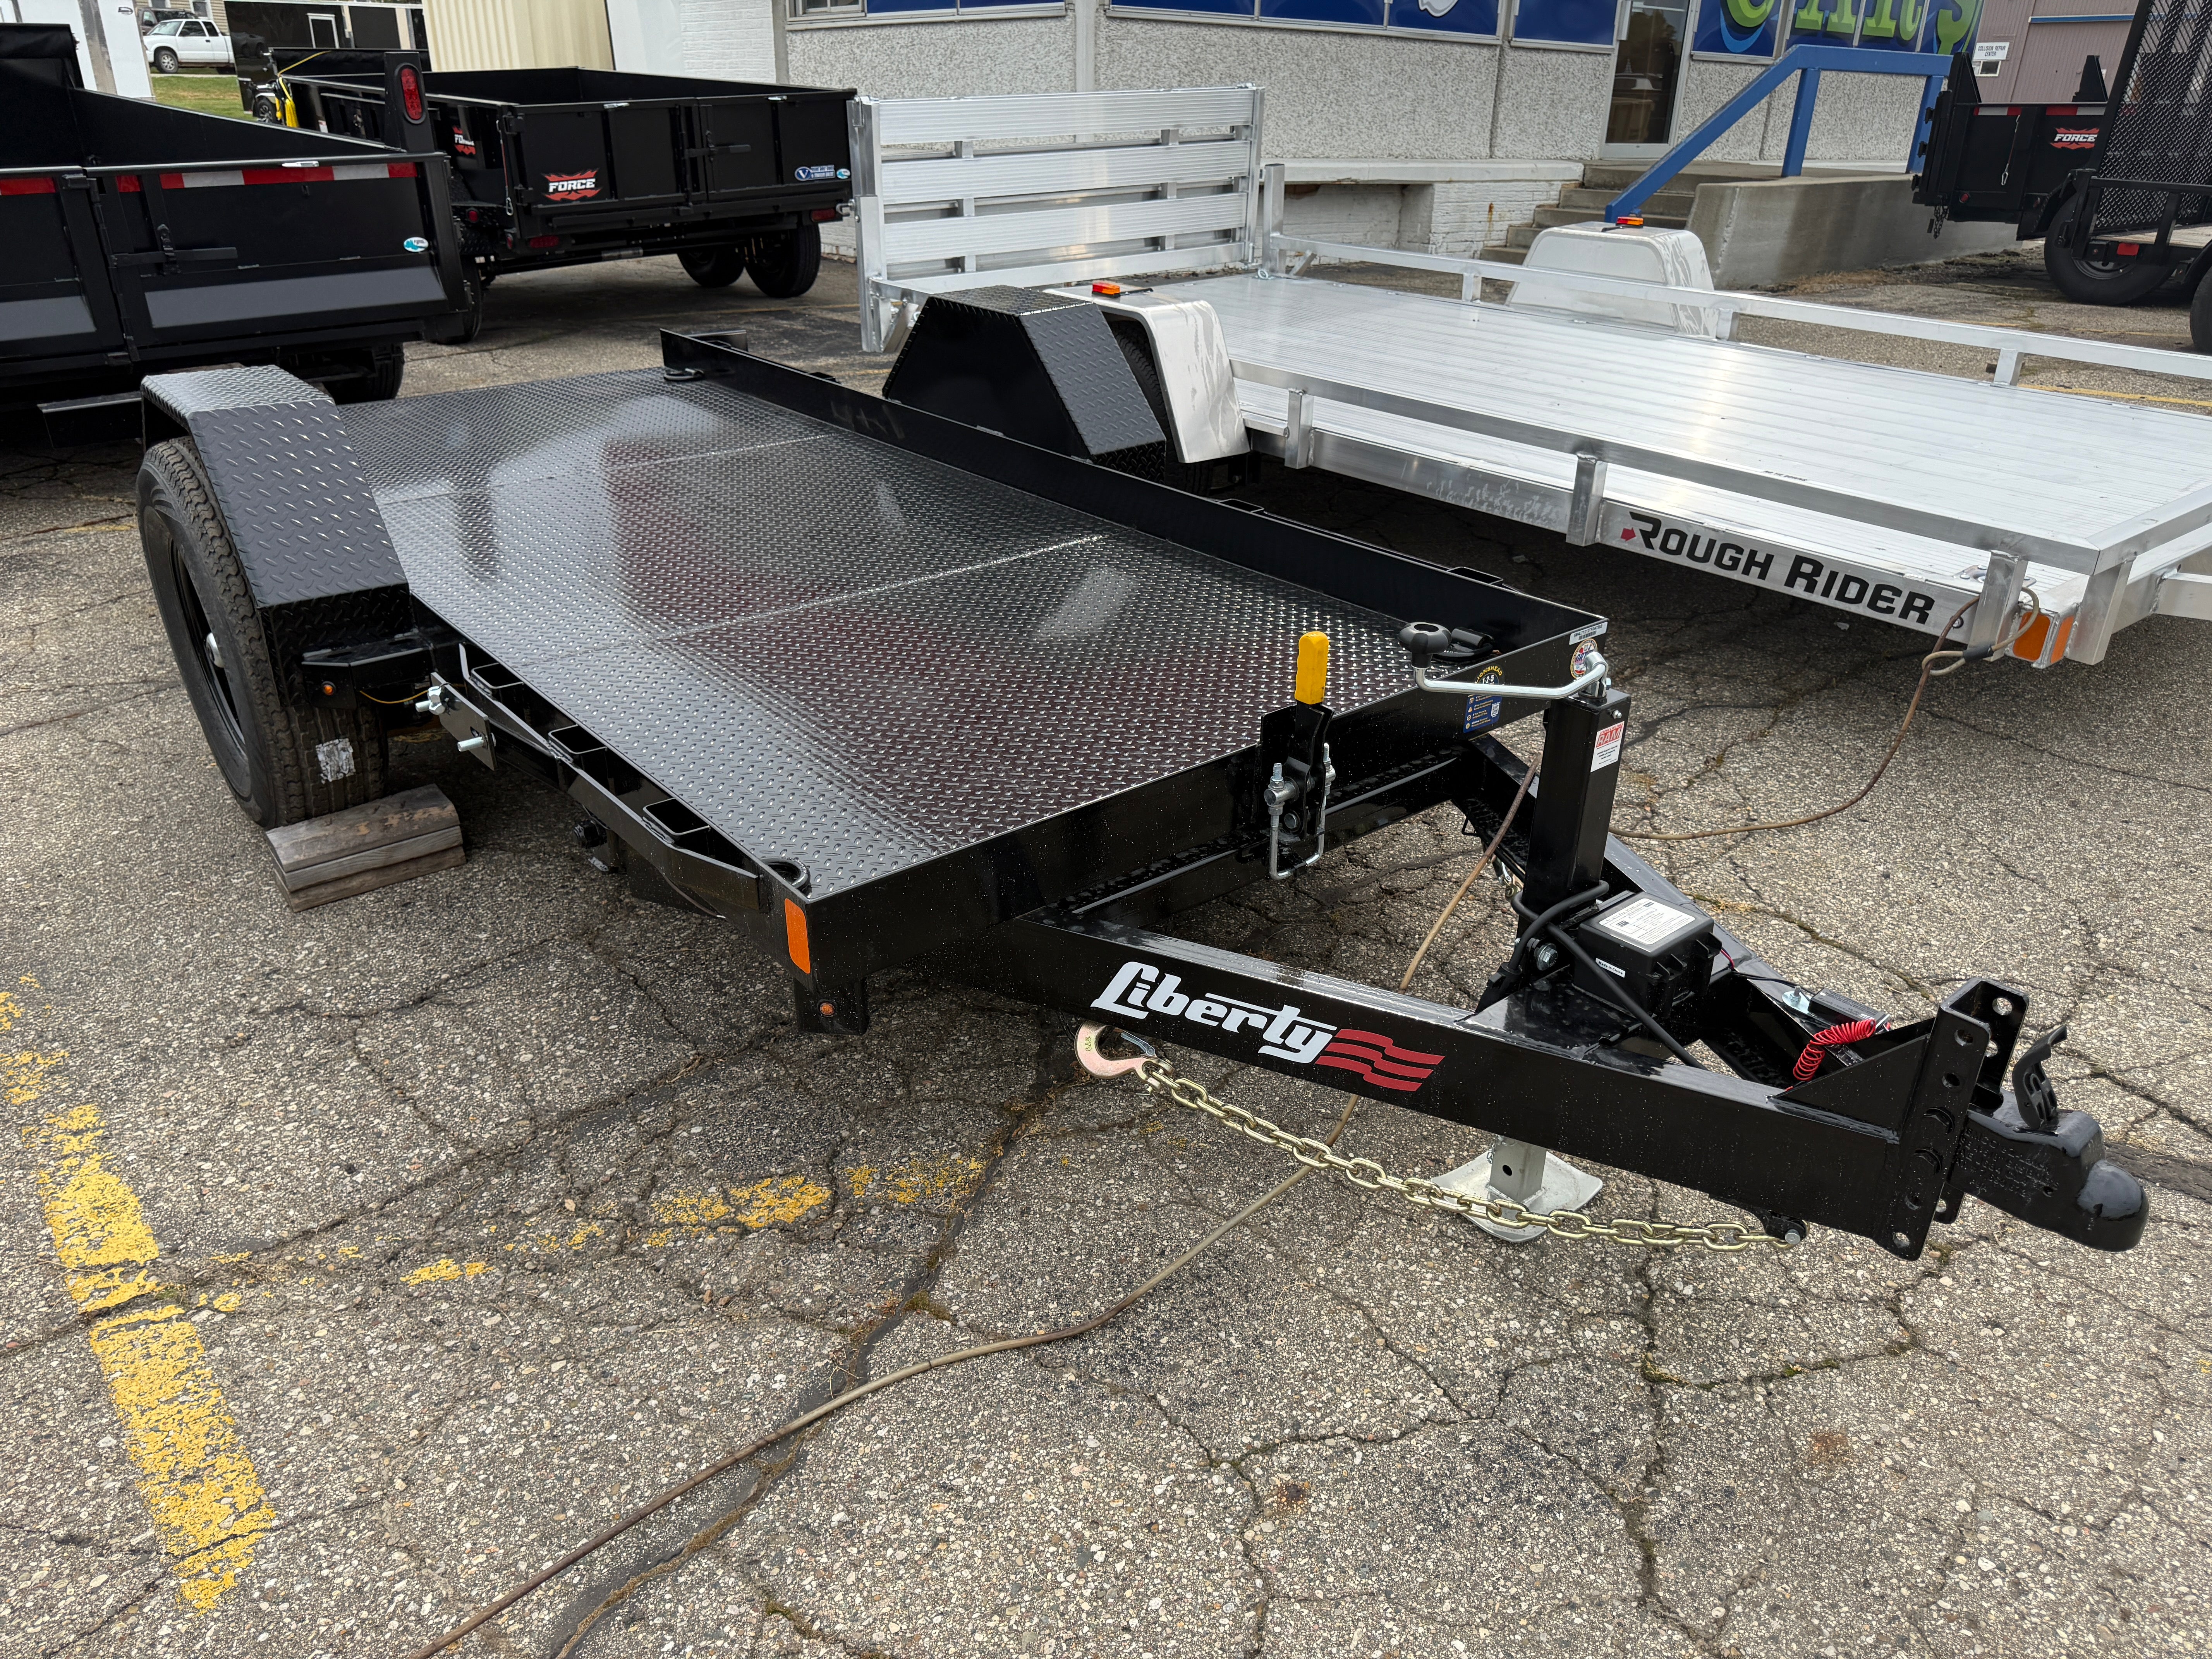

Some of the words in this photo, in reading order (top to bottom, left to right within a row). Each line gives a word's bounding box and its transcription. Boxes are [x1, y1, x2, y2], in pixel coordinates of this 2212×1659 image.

[548, 178, 596, 192] FORCE
[1629, 511, 1774, 580] ROUGH
[1784, 554, 1936, 625] RIDER
[1474, 665, 1503, 684] LIONSHEAD
[1597, 727, 1621, 747] RAM
[1090, 961, 1338, 1063] Liberty
